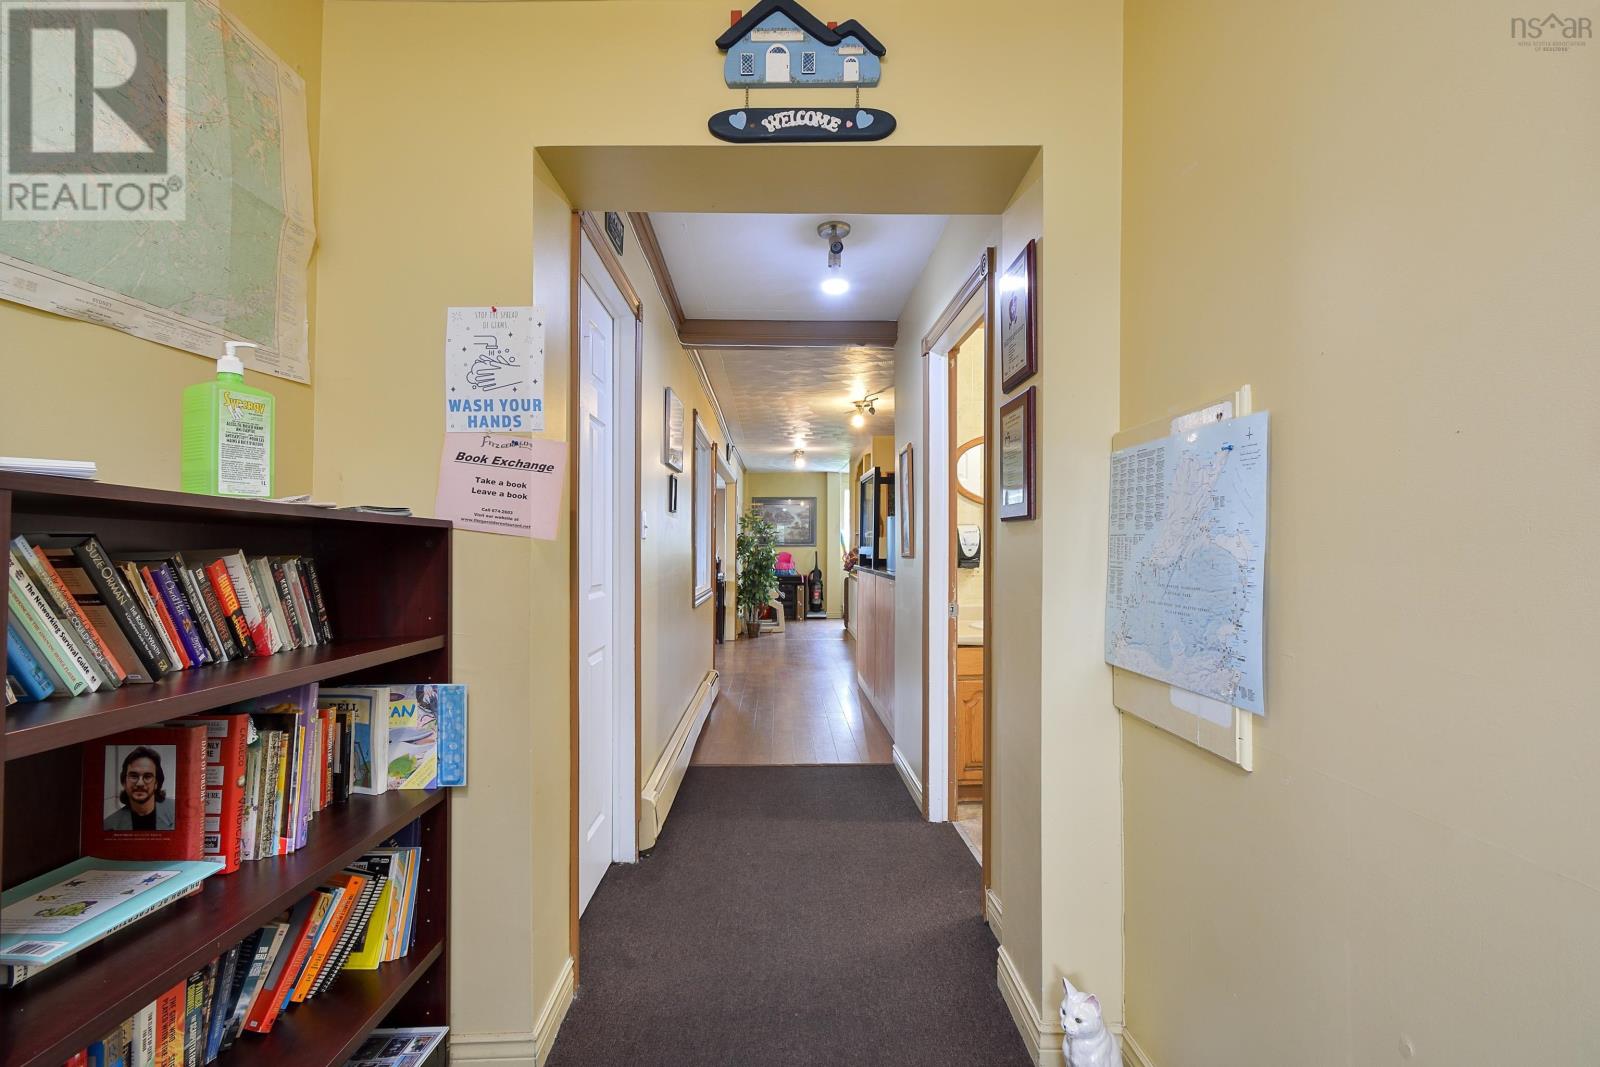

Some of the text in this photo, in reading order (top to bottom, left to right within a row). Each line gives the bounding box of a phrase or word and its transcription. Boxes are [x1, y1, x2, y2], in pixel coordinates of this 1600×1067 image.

[761, 110, 842, 133] WELCOME
[448, 399, 542, 412] WASH YOUR
[468, 415, 522, 428] HANDS
[456, 452, 554, 473] Book Exchange
[472, 488, 496, 497] Leave
[507, 491, 528, 500] book
[475, 476, 496, 486] Take
[506, 480, 527, 489] book
[84, 541, 129, 606] SUZE ORMAN
[217, 576, 240, 612] HUNTER
[279, 578, 288, 594] KEN
[284, 594, 298, 625] FOLLETT
[201, 586, 218, 613] KAREN
[212, 612, 230, 641] HARPER
[236, 614, 250, 638] HOT
[24, 582, 90, 674] The Networking Survival Guide
[69, 615, 90, 641] COULD
[85, 638, 105, 663] REACH
[129, 605, 138, 616] THE
[134, 615, 147, 631] ROAD
[146, 634, 161, 655] WEALTH
[230, 614, 246, 647] SPRINGS
[390, 704, 416, 718] AN
[200, 761, 205, 770] OF
[233, 727, 246, 865] CANSECO VINDICATED
